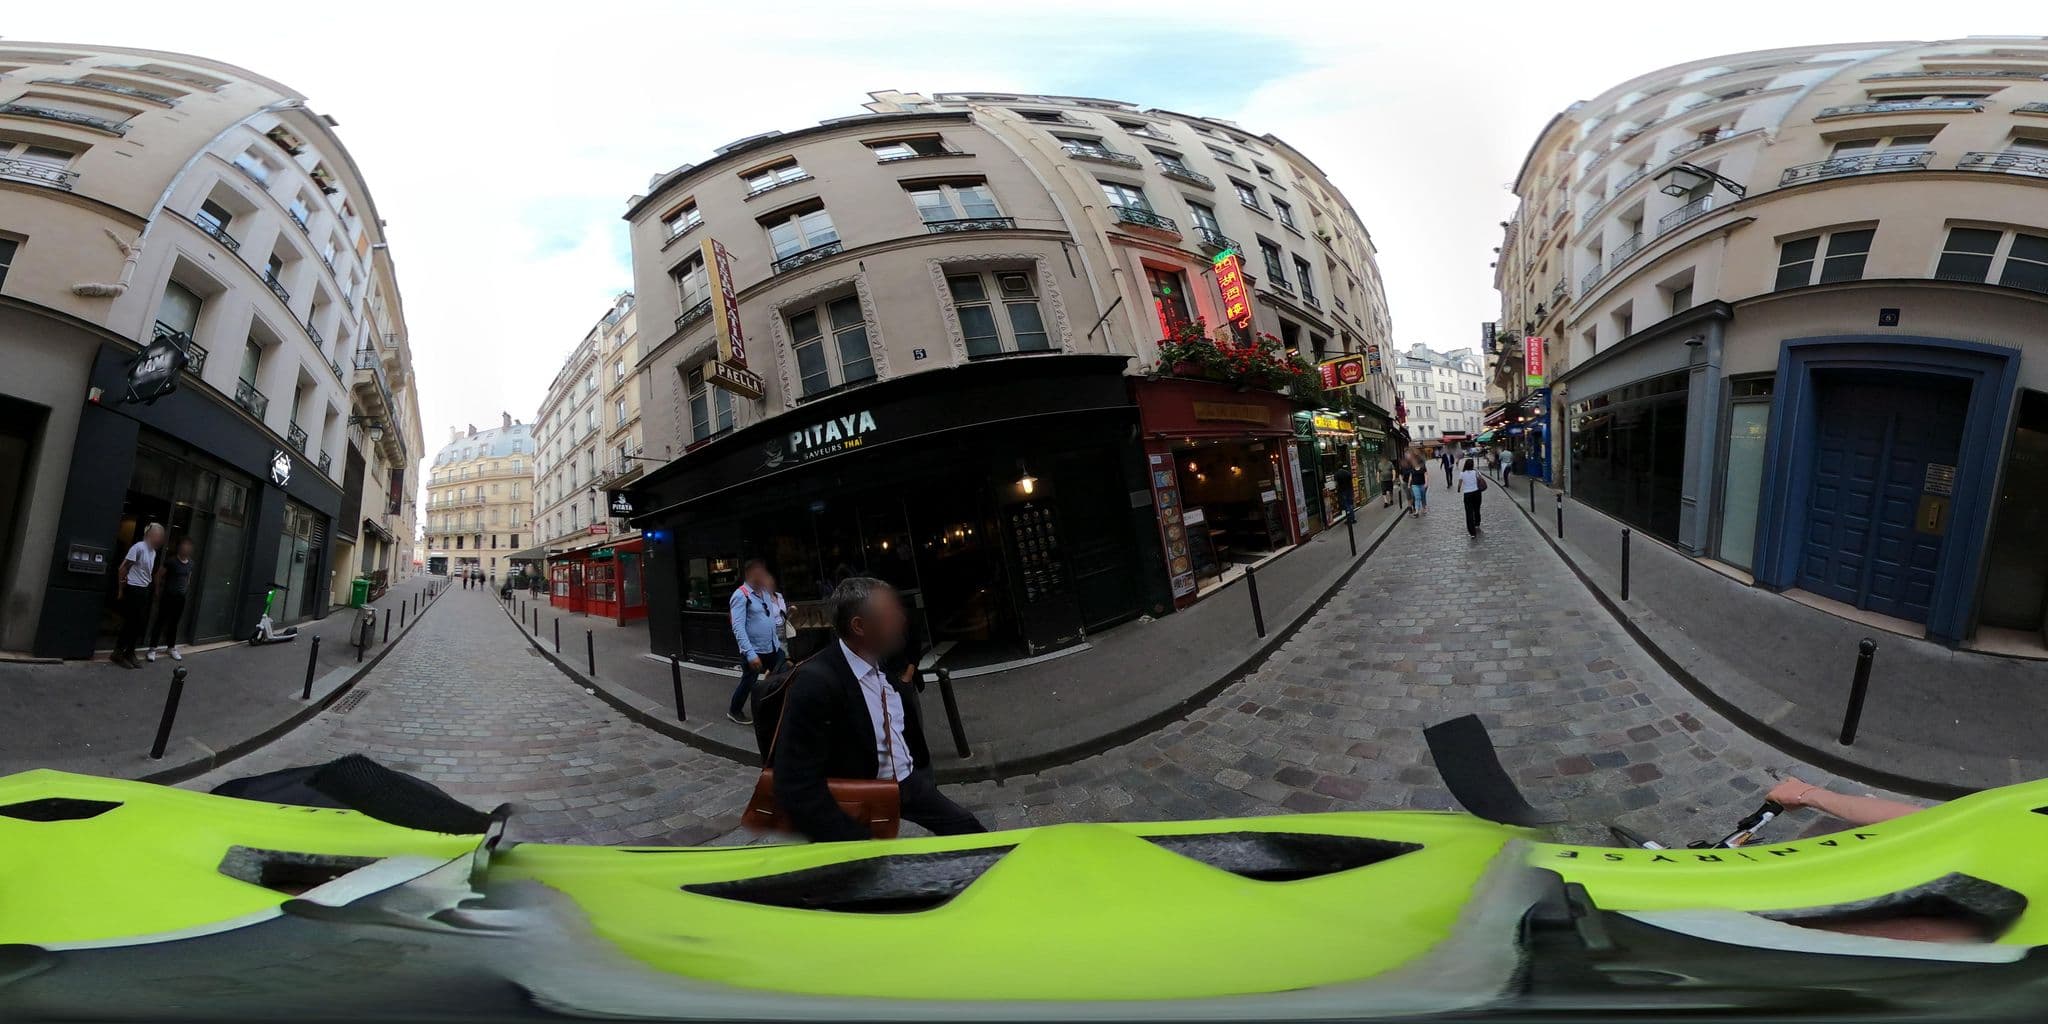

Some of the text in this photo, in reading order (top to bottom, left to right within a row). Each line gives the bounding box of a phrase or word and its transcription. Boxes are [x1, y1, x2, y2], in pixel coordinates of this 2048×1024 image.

[725, 299, 746, 360] LATINO
[915, 349, 924, 360] 5
[718, 364, 760, 393] PAELLA
[788, 409, 877, 453] PITAYA
[804, 444, 843, 460] SAVEURS
[612, 503, 633, 511] PITAYA
[1769, 832, 1878, 857] VAN
